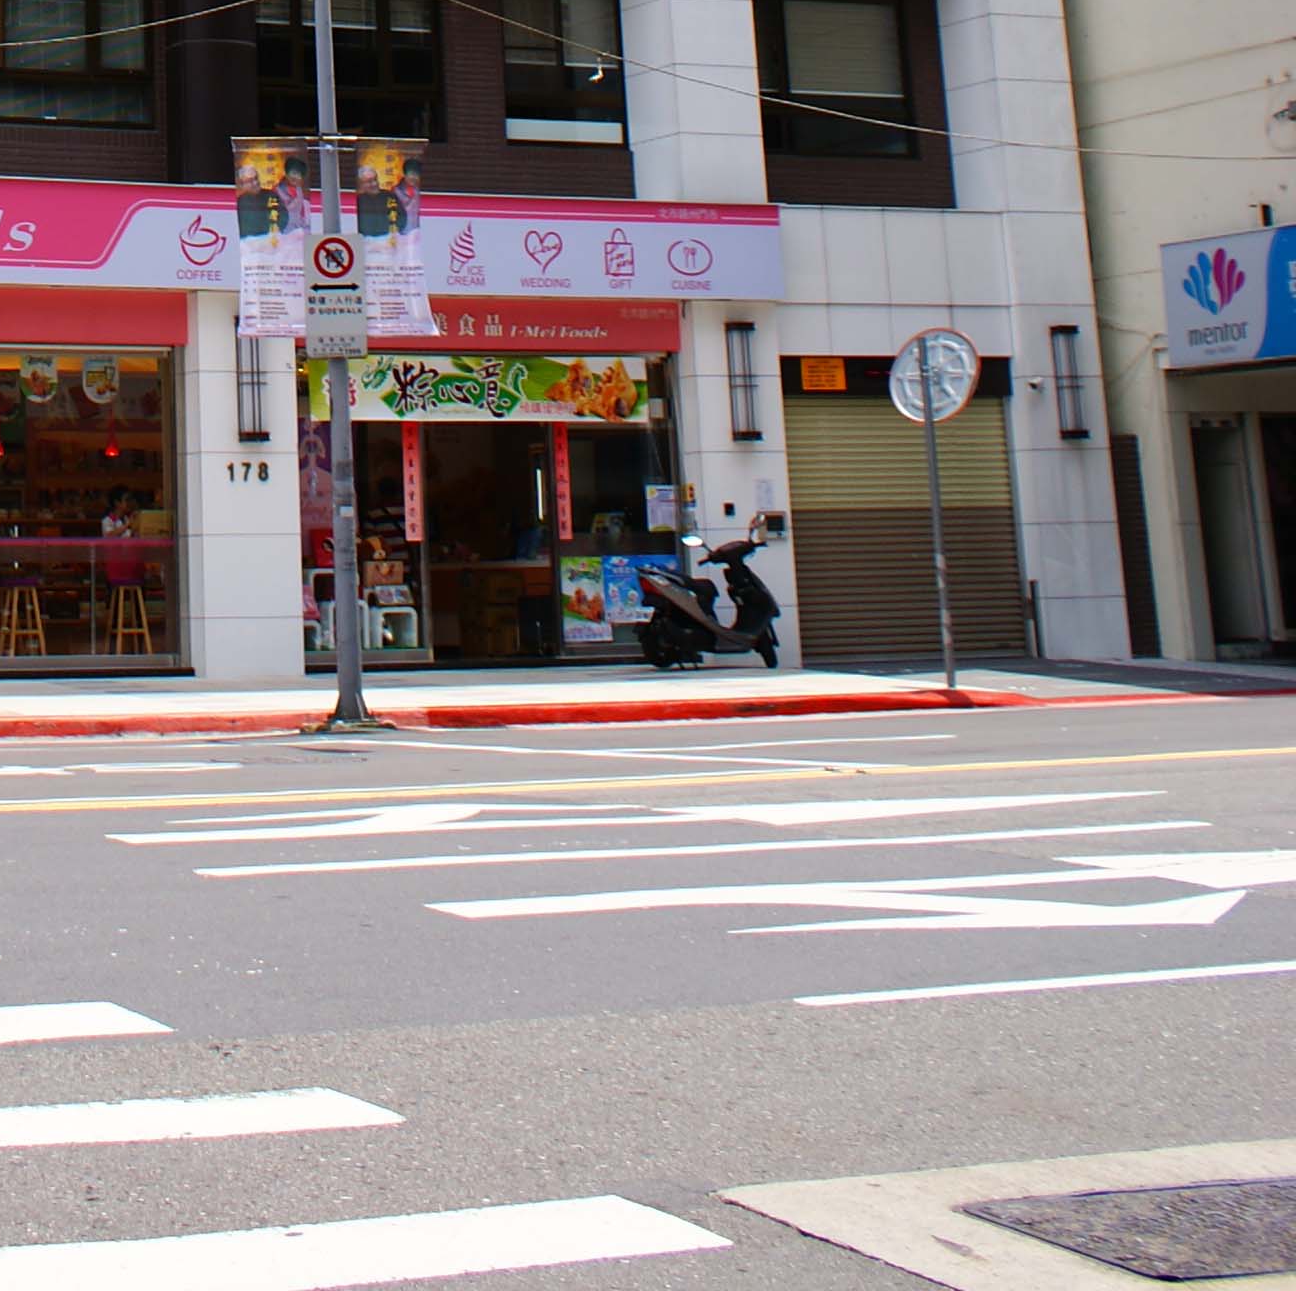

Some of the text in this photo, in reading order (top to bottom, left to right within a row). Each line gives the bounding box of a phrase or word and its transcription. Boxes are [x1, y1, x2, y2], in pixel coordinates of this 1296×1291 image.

[176, 269, 223, 281] COFFEE
[467, 265, 485, 275] ICE
[447, 275, 486, 286] CREAM
[520, 278, 571, 289] WEDDING
[609, 279, 632, 290] GIFT
[672, 280, 712, 291] CUISINE
[1188, 322, 1248, 347] mentor
[227, 462, 269, 482] 178
